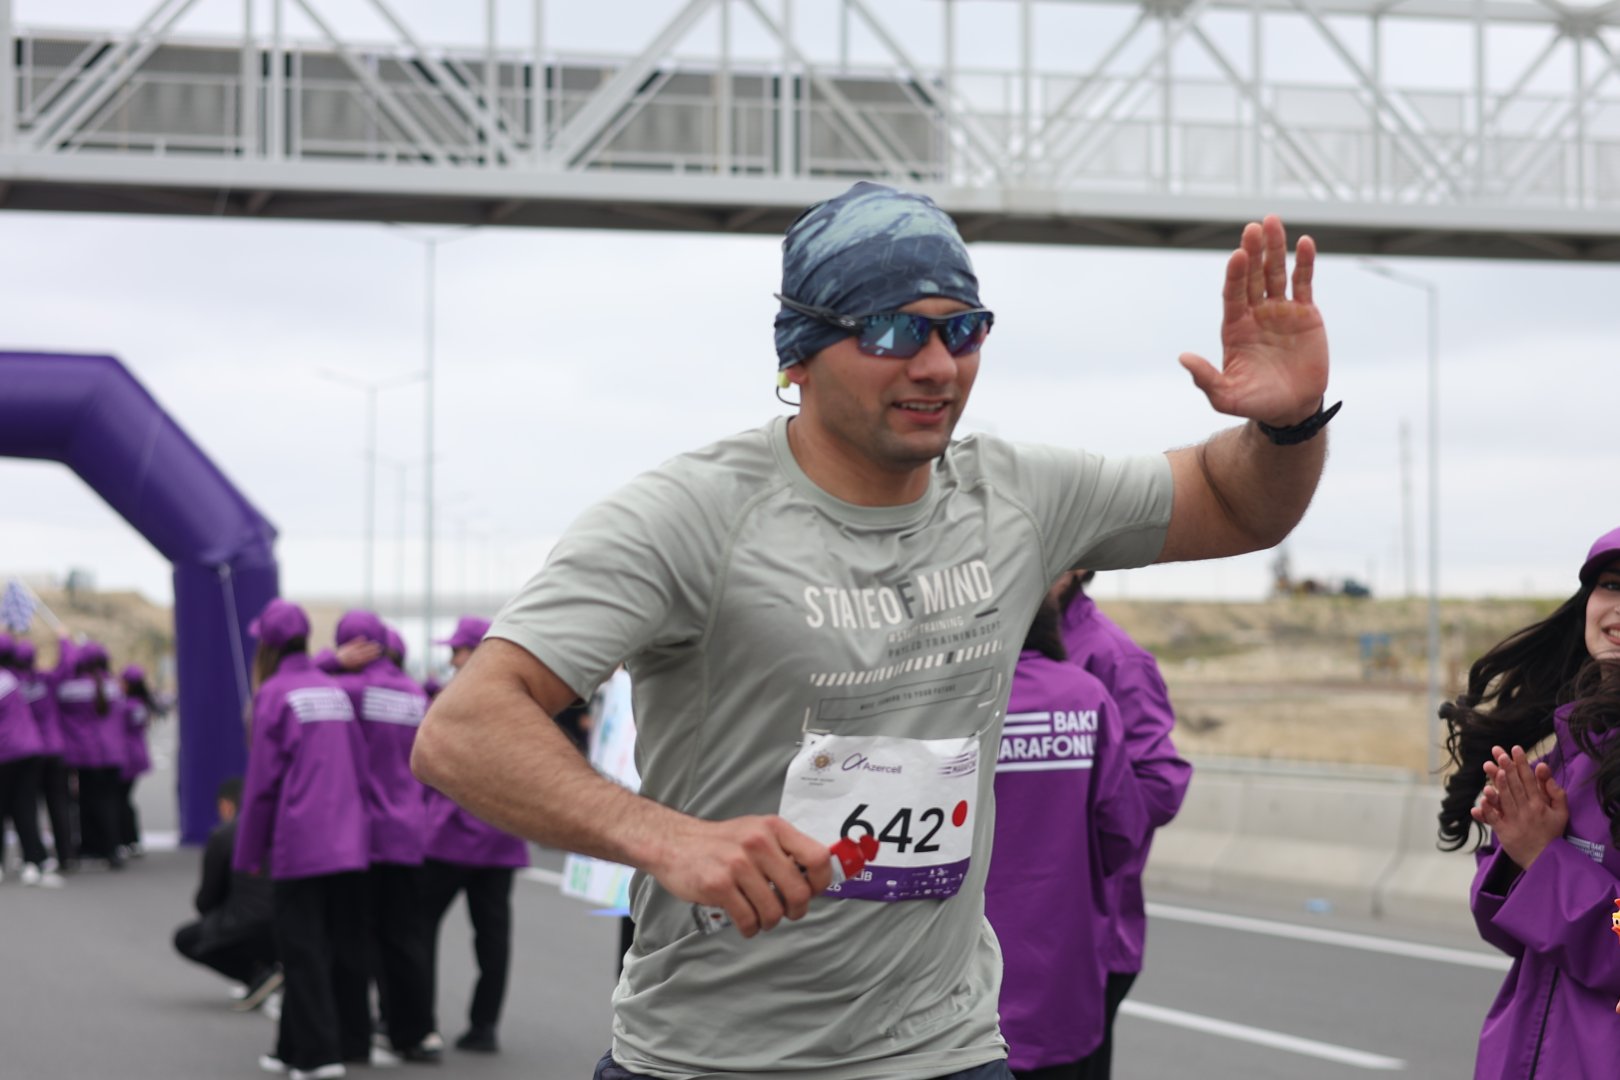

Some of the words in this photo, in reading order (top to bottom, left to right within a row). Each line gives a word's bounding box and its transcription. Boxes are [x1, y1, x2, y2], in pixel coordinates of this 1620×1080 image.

[917, 559, 993, 615] MIND
[999, 734, 1096, 760] ARAFONU
[863, 763, 902, 775] Azercell
[840, 803, 945, 853] 642
